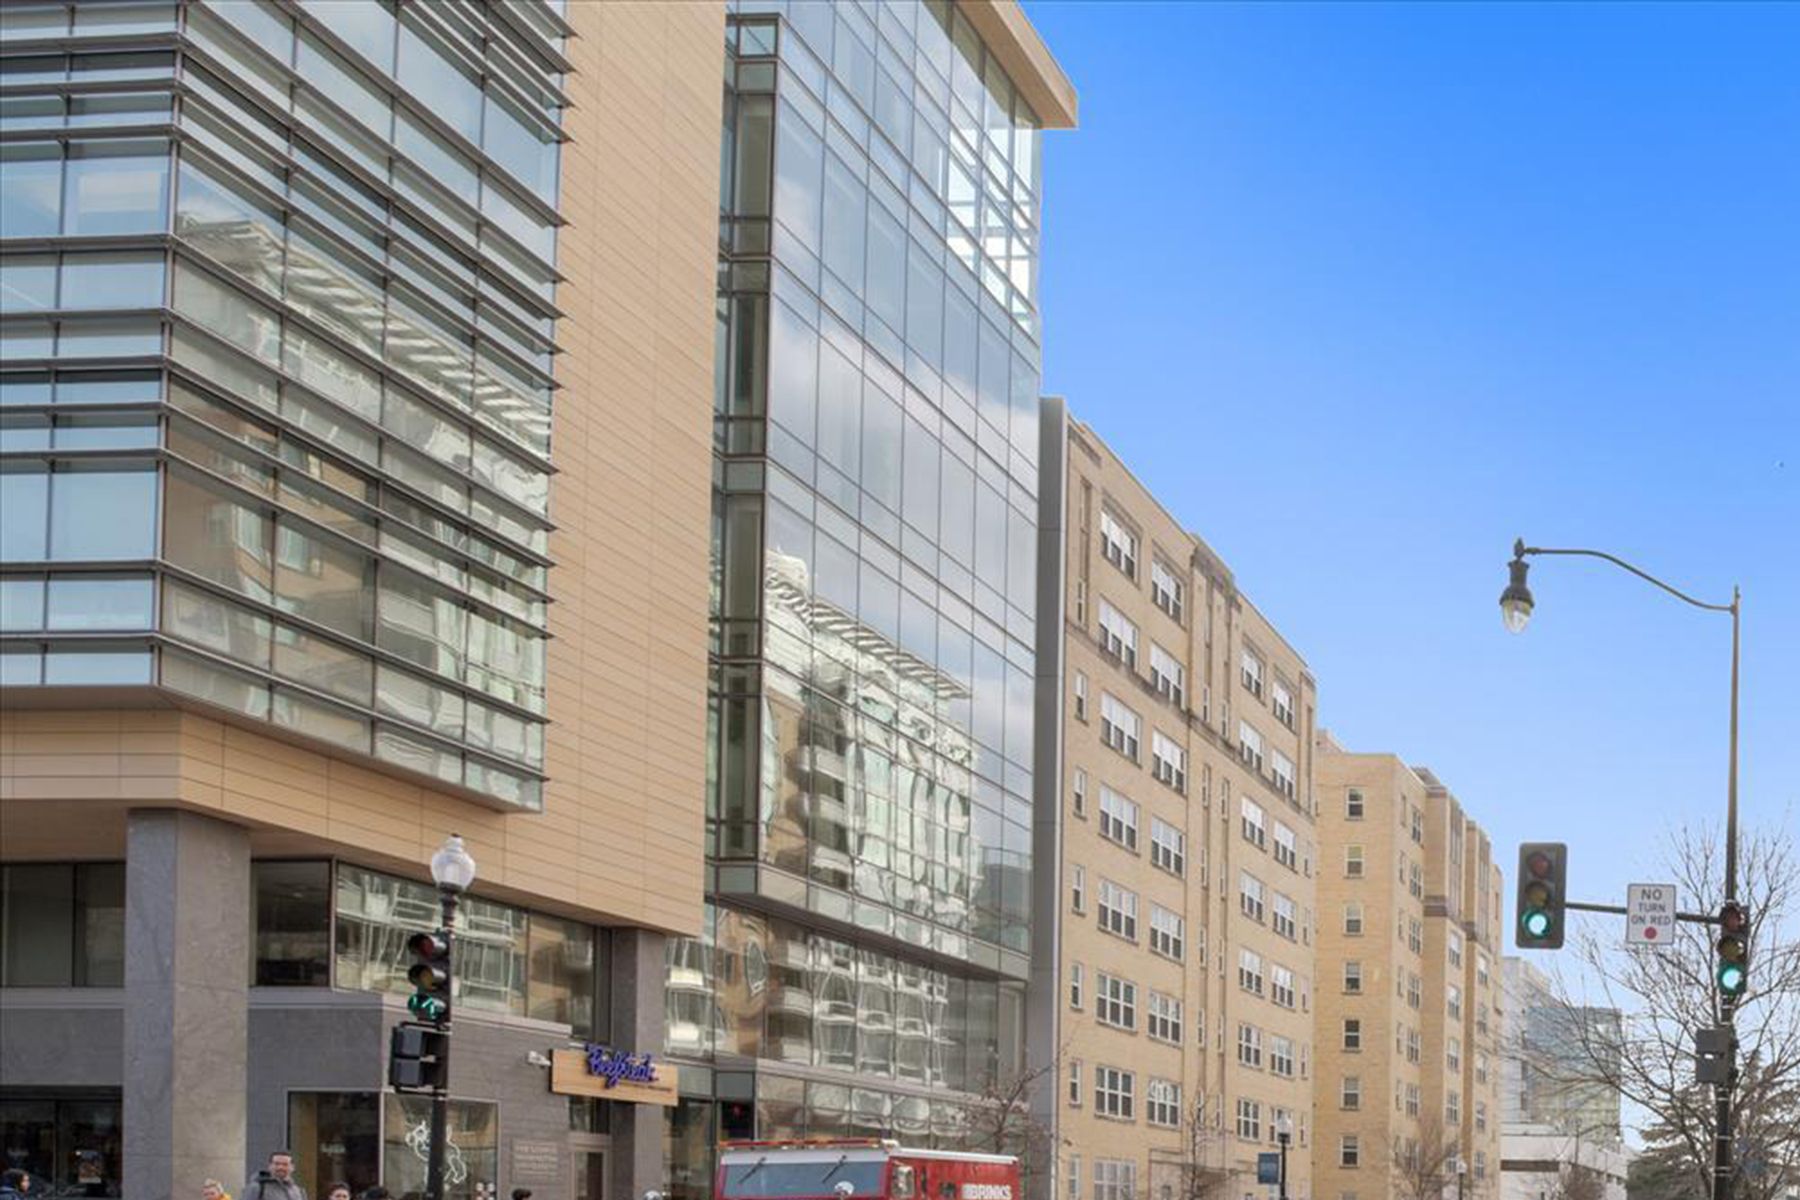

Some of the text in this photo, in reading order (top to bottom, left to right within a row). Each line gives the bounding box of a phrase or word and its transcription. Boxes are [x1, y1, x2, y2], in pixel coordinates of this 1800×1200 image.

[1641, 888, 1662, 901] NO
[1638, 901, 1666, 912] TURN
[1630, 914, 1671, 926] ON RED
